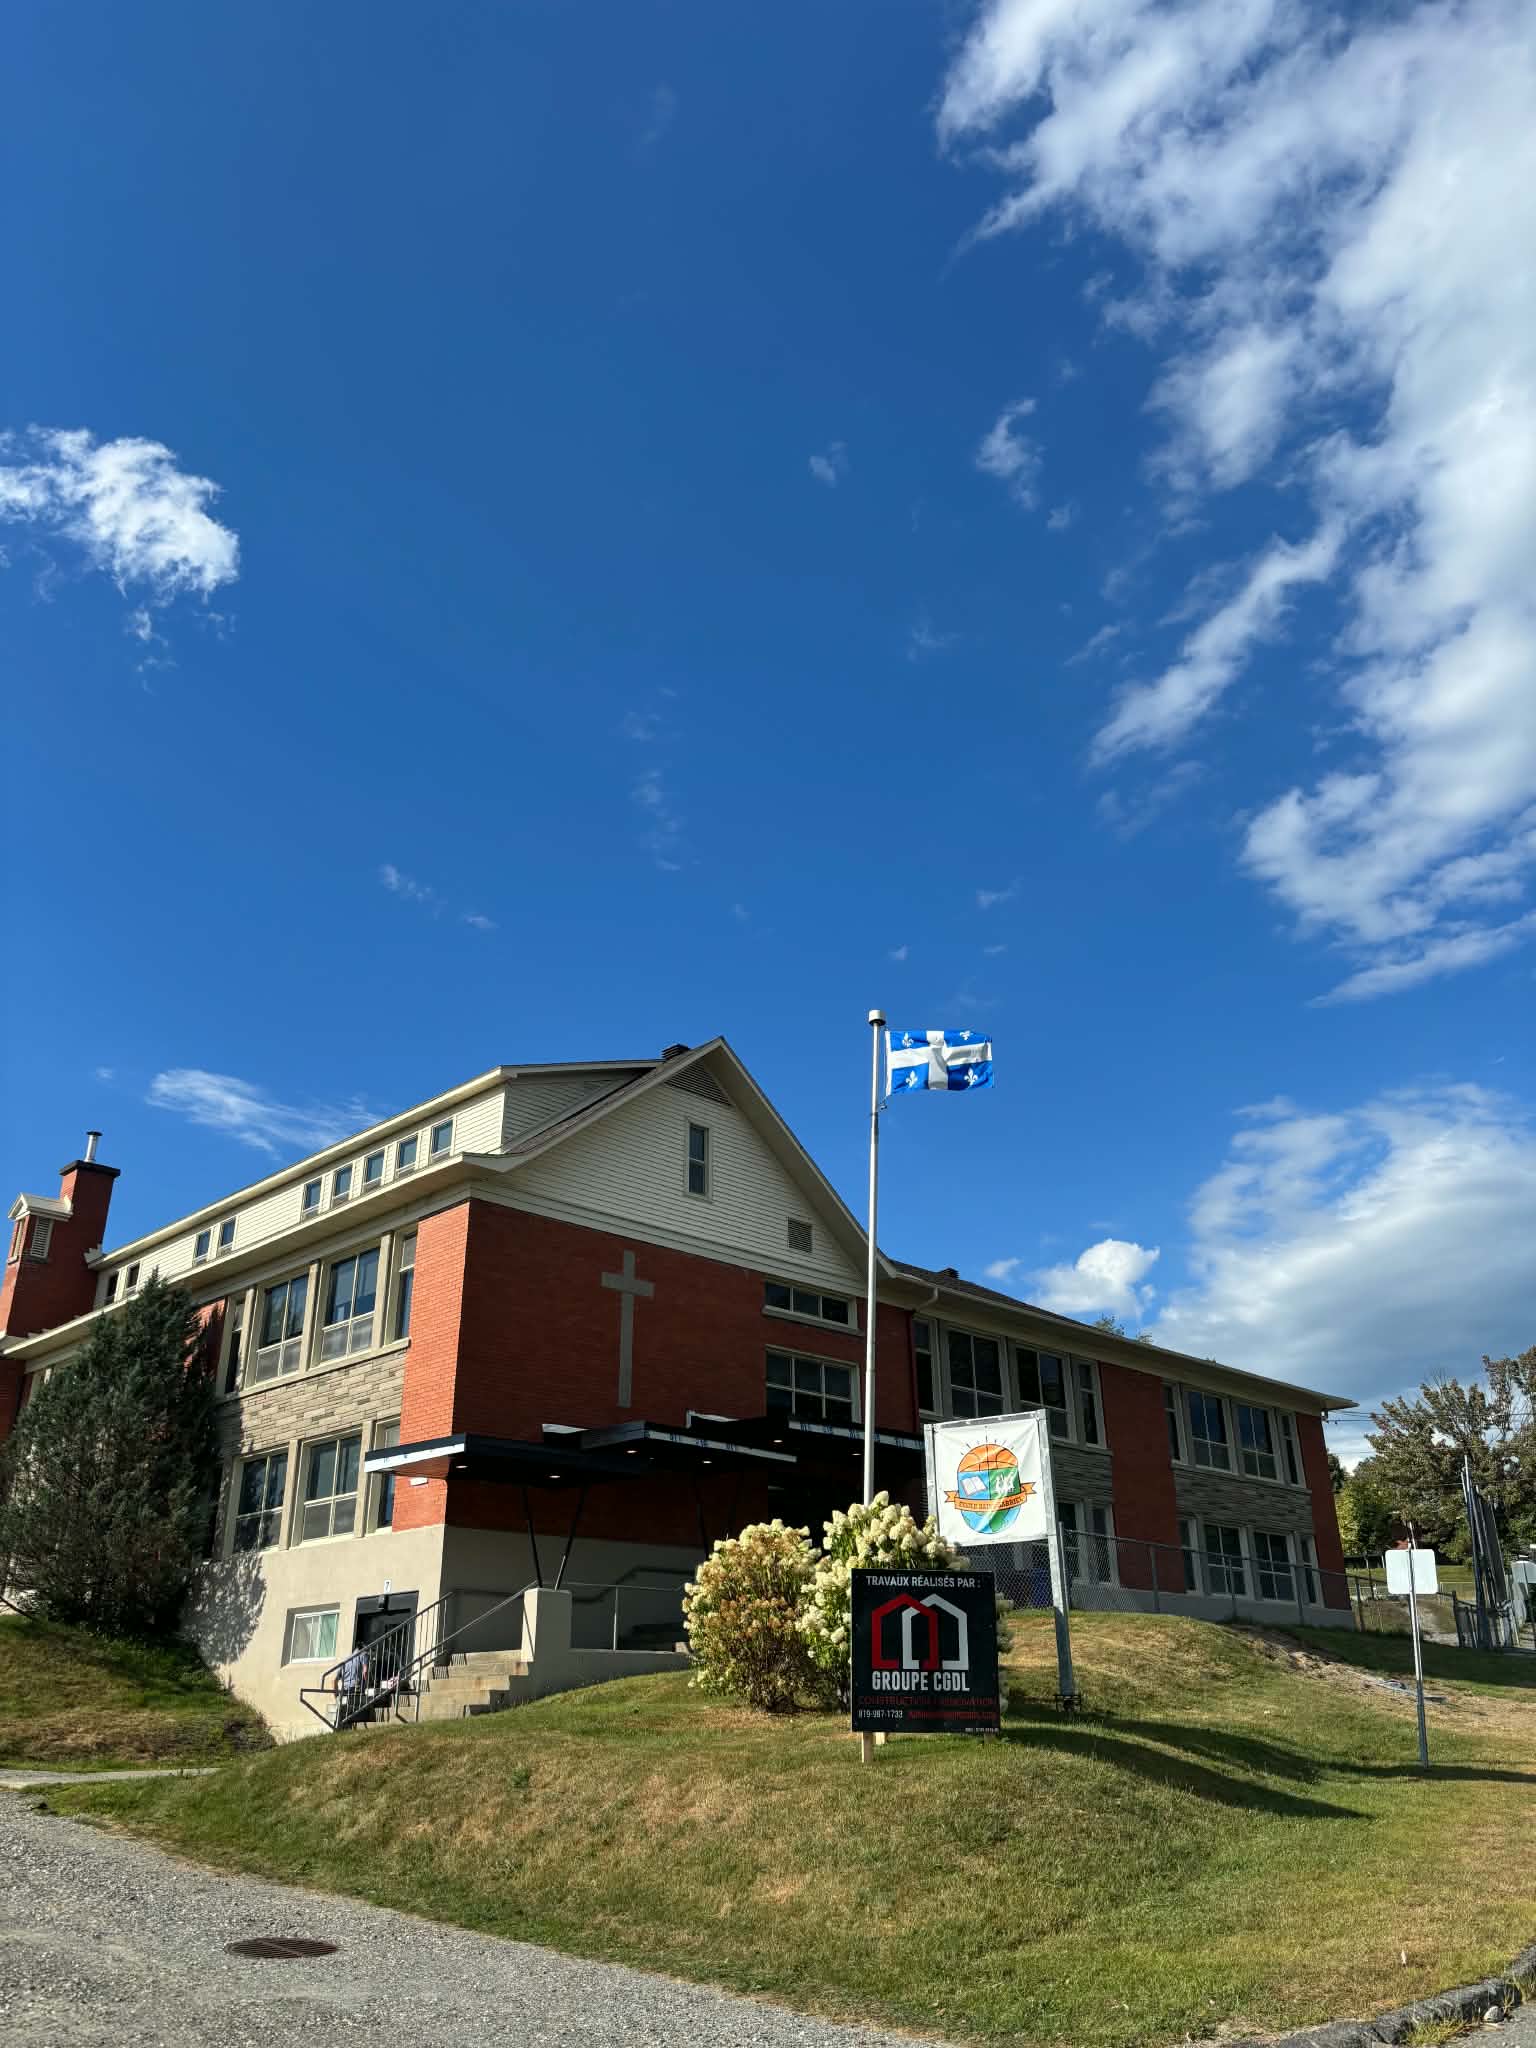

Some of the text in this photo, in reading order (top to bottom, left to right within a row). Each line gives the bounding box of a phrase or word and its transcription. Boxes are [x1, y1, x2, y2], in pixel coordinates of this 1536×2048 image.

[385, 1581, 390, 1591] 7
[865, 1575, 909, 1586] TRAVAUX
[911, 1574, 955, 1588] RÉALISÉS
[957, 1577, 975, 1588] PAR
[872, 1671, 970, 1691] GROUPE CGDL
